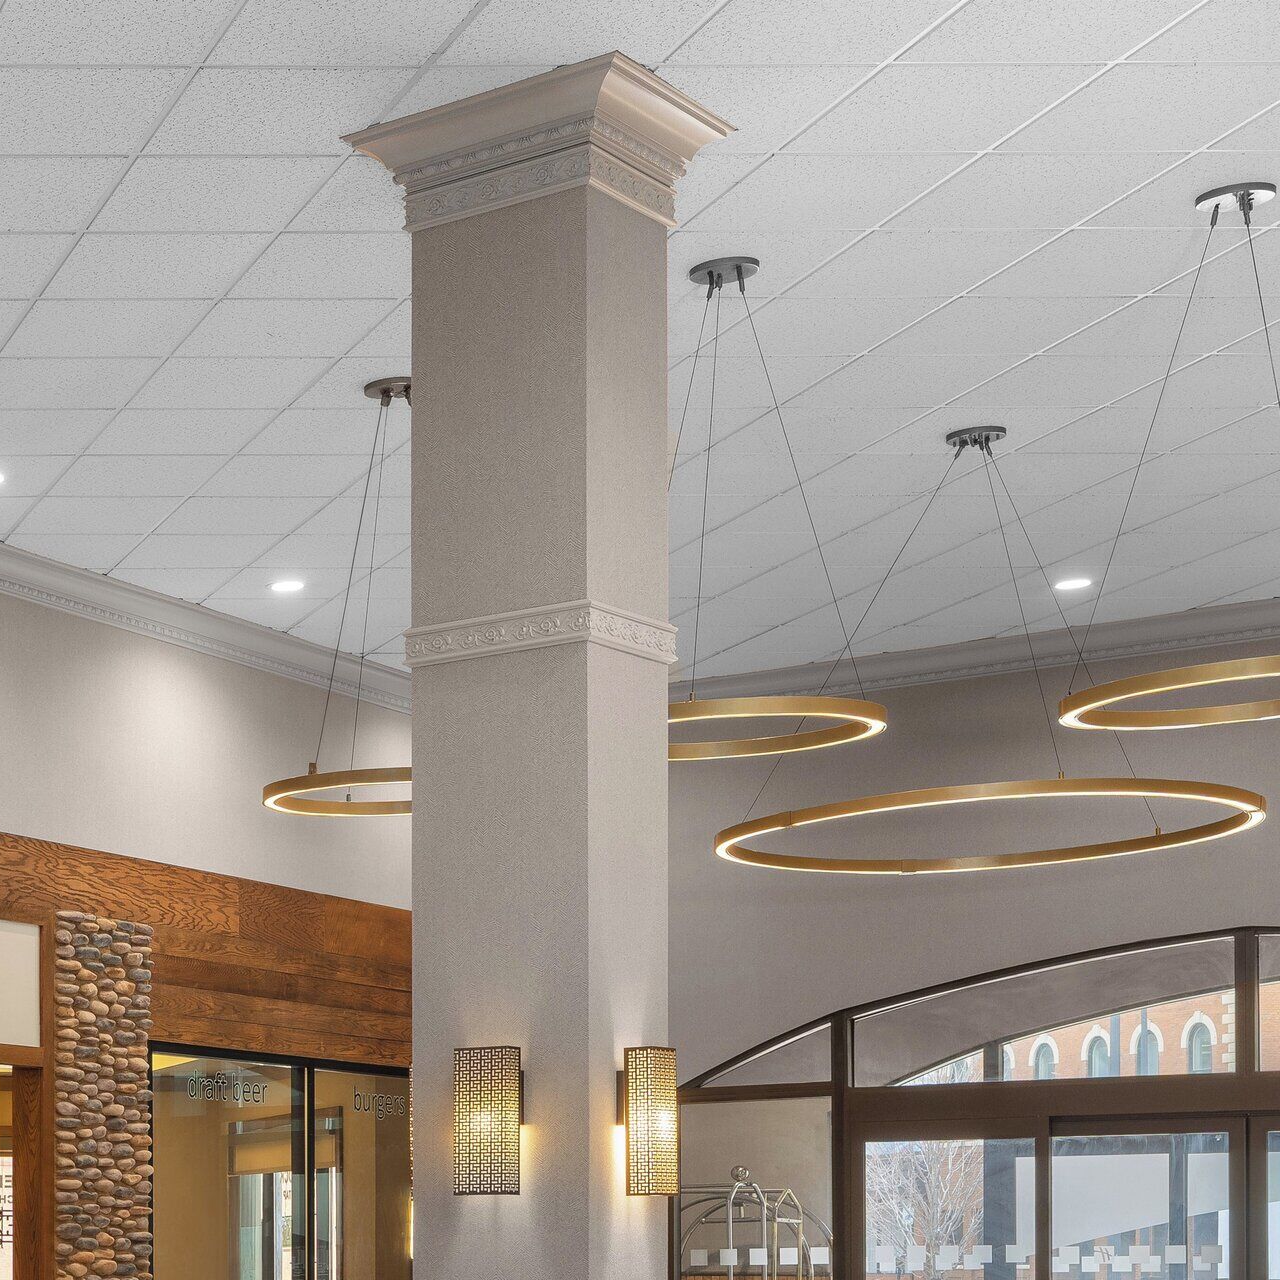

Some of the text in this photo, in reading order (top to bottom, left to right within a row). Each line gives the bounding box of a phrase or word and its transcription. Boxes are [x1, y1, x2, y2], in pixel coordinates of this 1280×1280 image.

[188, 1069, 268, 1103] draft beer
[352, 1085, 406, 1120] burgers
